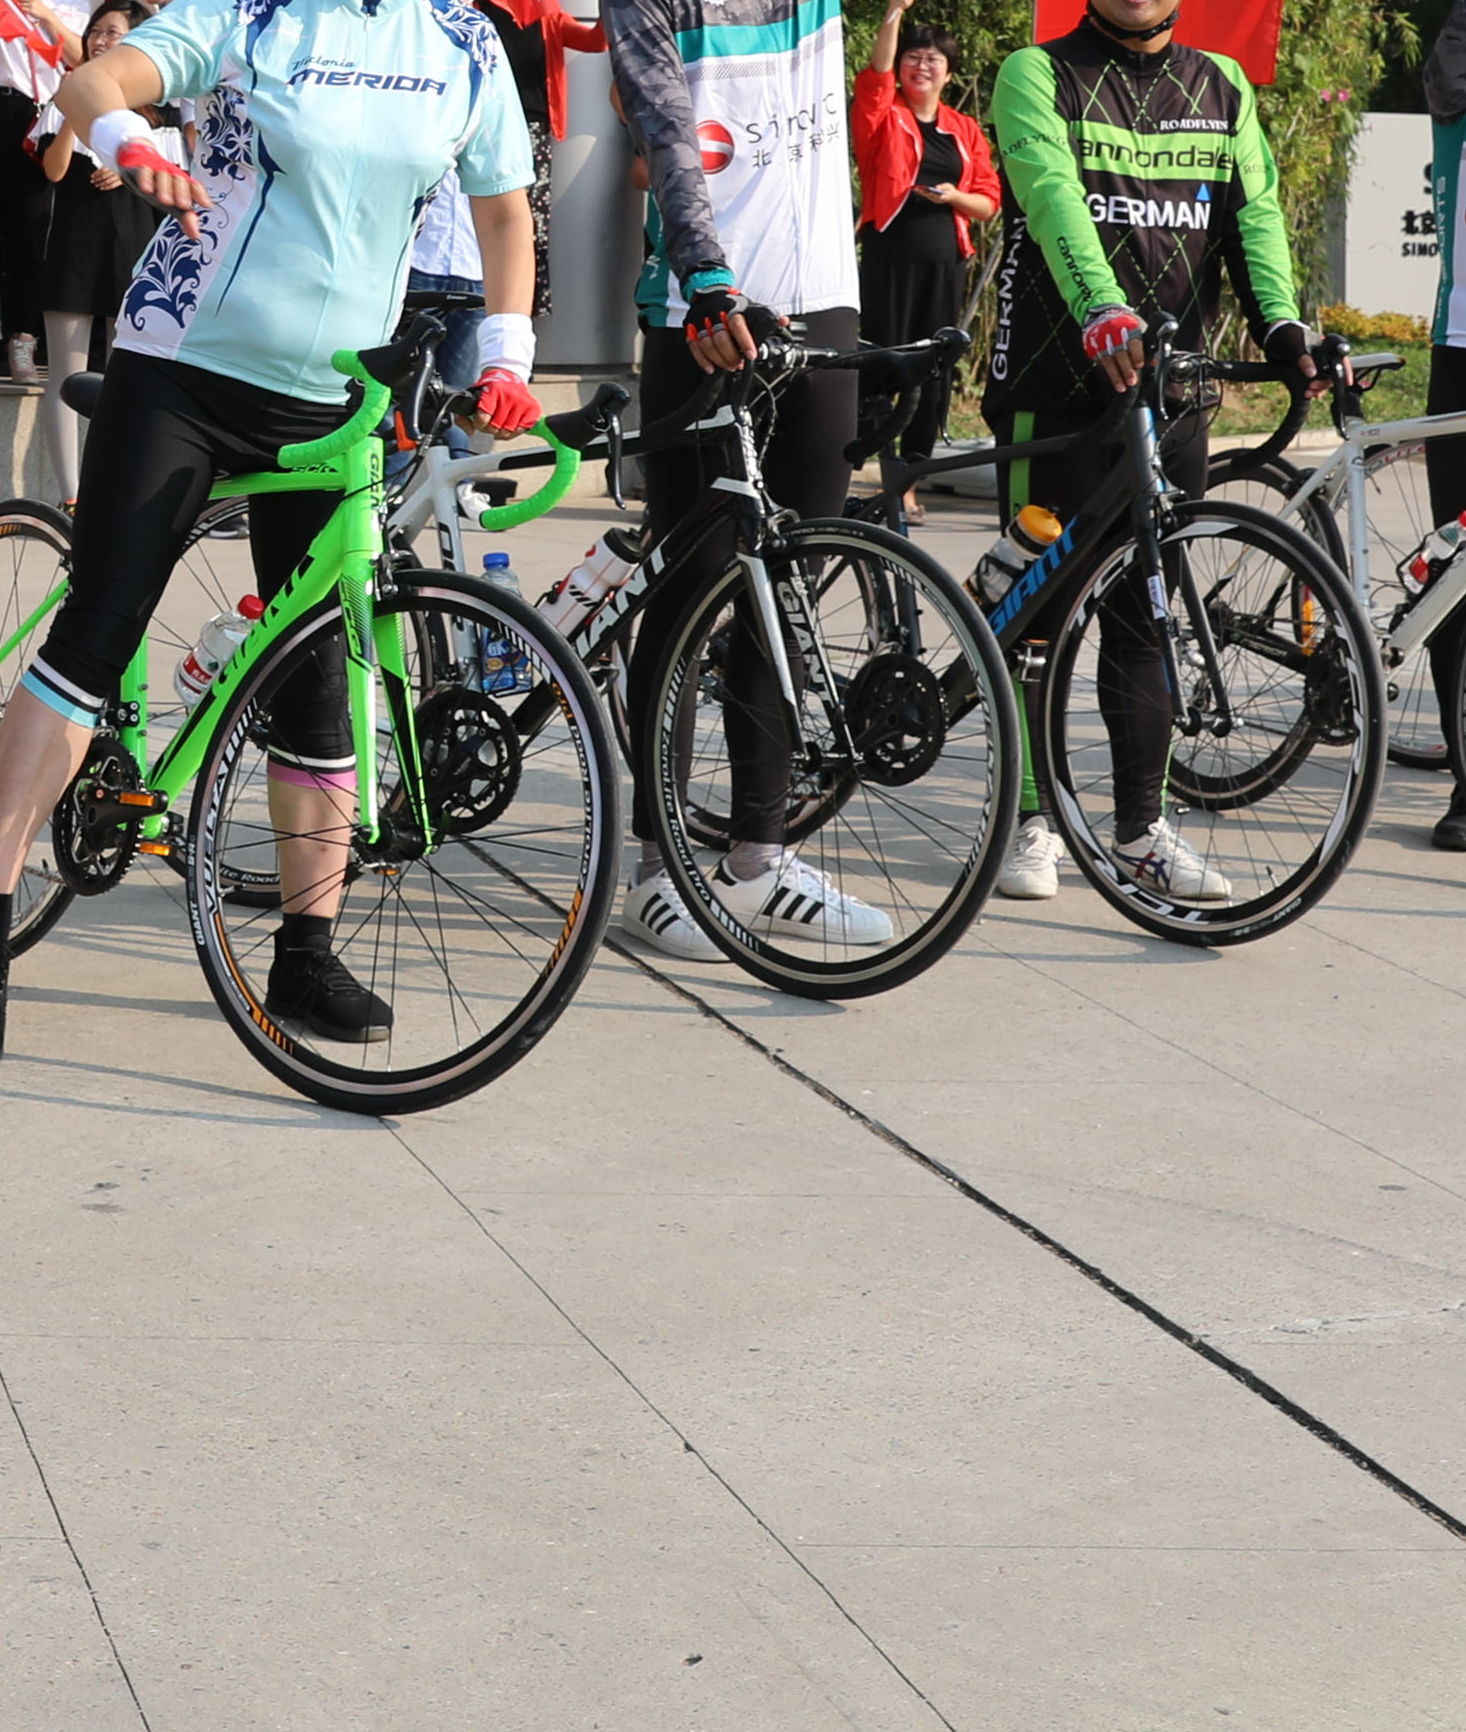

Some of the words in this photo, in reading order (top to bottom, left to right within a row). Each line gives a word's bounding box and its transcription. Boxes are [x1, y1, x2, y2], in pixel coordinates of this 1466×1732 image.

[286, 68, 447, 96] MERIDA
[1159, 119, 1229, 132] ROADFLYIN
[1086, 193, 1212, 230] GERMAN
[1401, 242, 1437, 258] SINO
[988, 515, 1077, 637] GIANT
[573, 536, 669, 661] IANT
[776, 580, 836, 714] GIANT
[669, 819, 694, 867] Road
